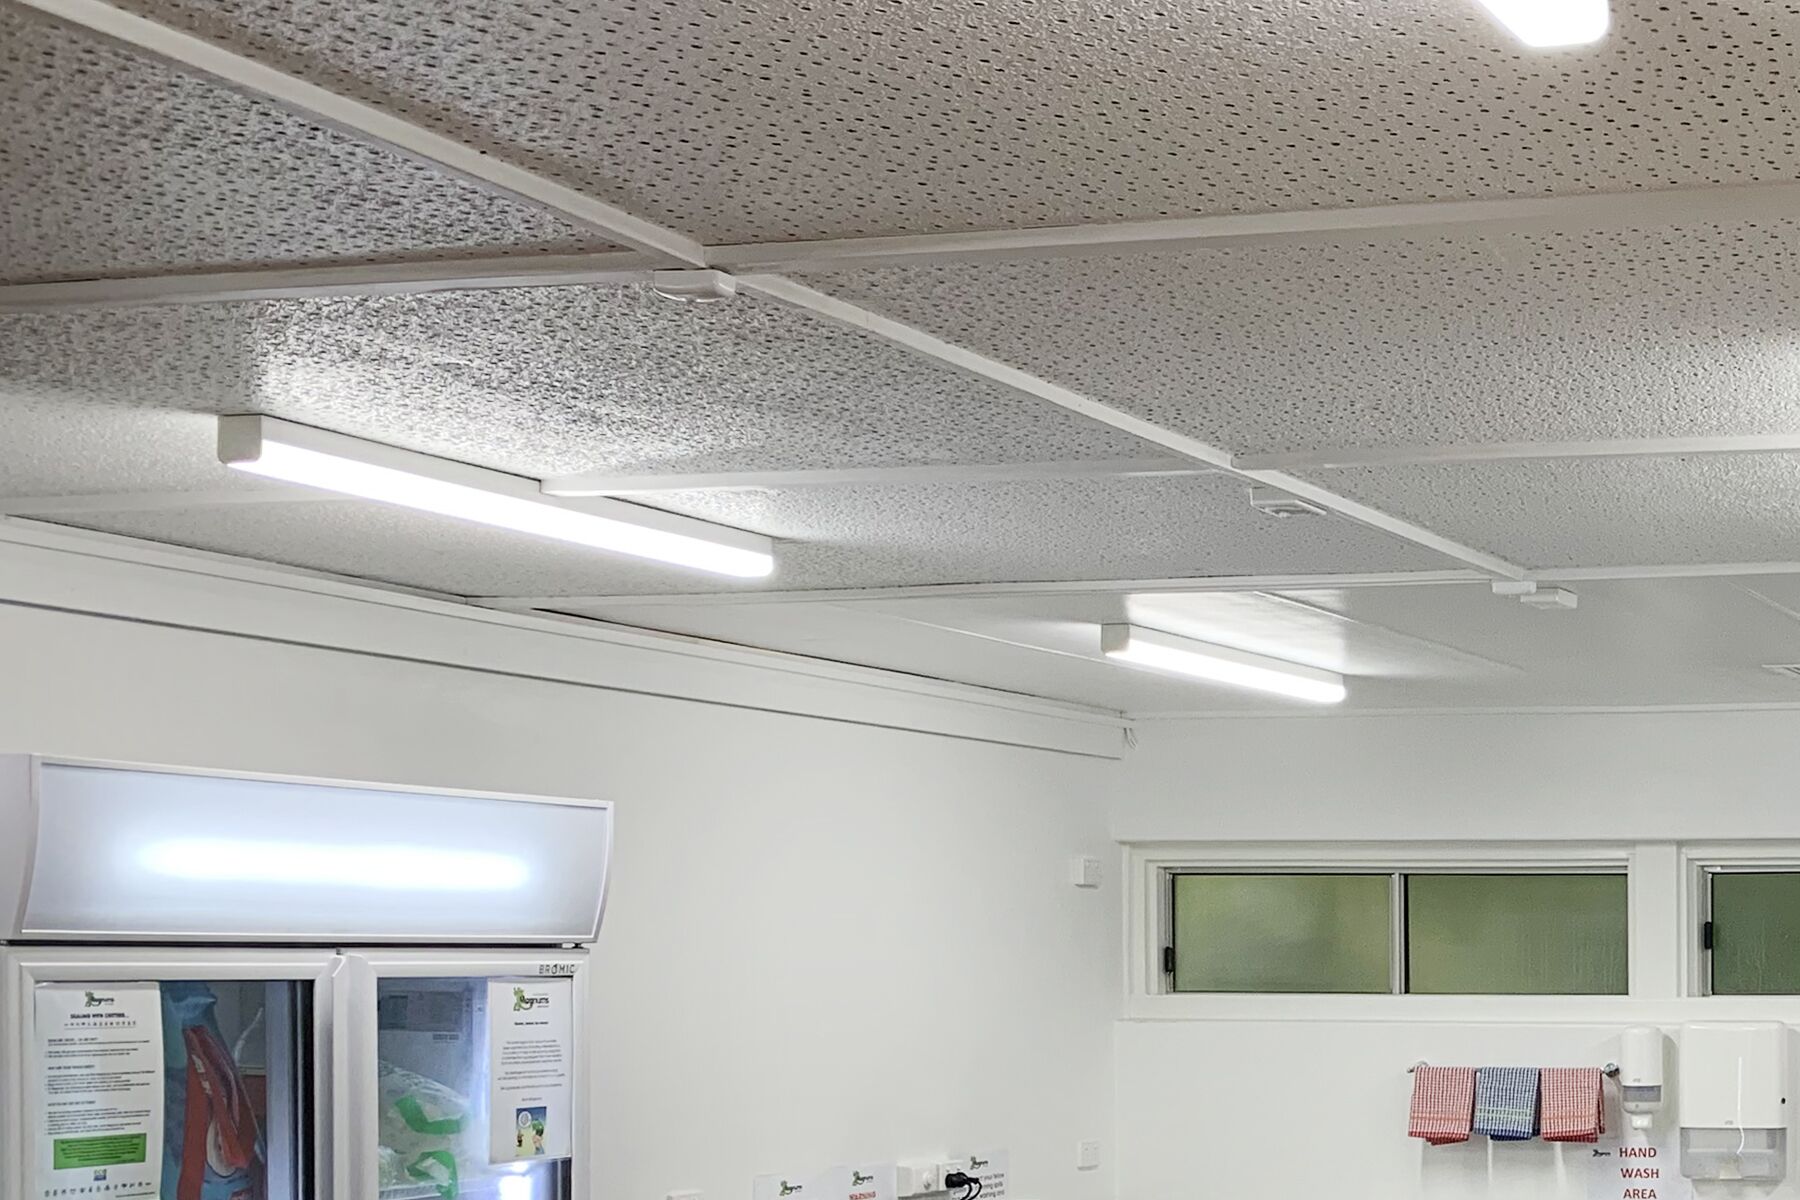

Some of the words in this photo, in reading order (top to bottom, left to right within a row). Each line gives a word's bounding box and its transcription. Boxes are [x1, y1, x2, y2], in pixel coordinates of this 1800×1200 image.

[539, 963, 575, 974] BROMIC
[1619, 1147, 1657, 1158] HAND
[1620, 1167, 1660, 1179] WASH
[1623, 1188, 1657, 1200] AREA
